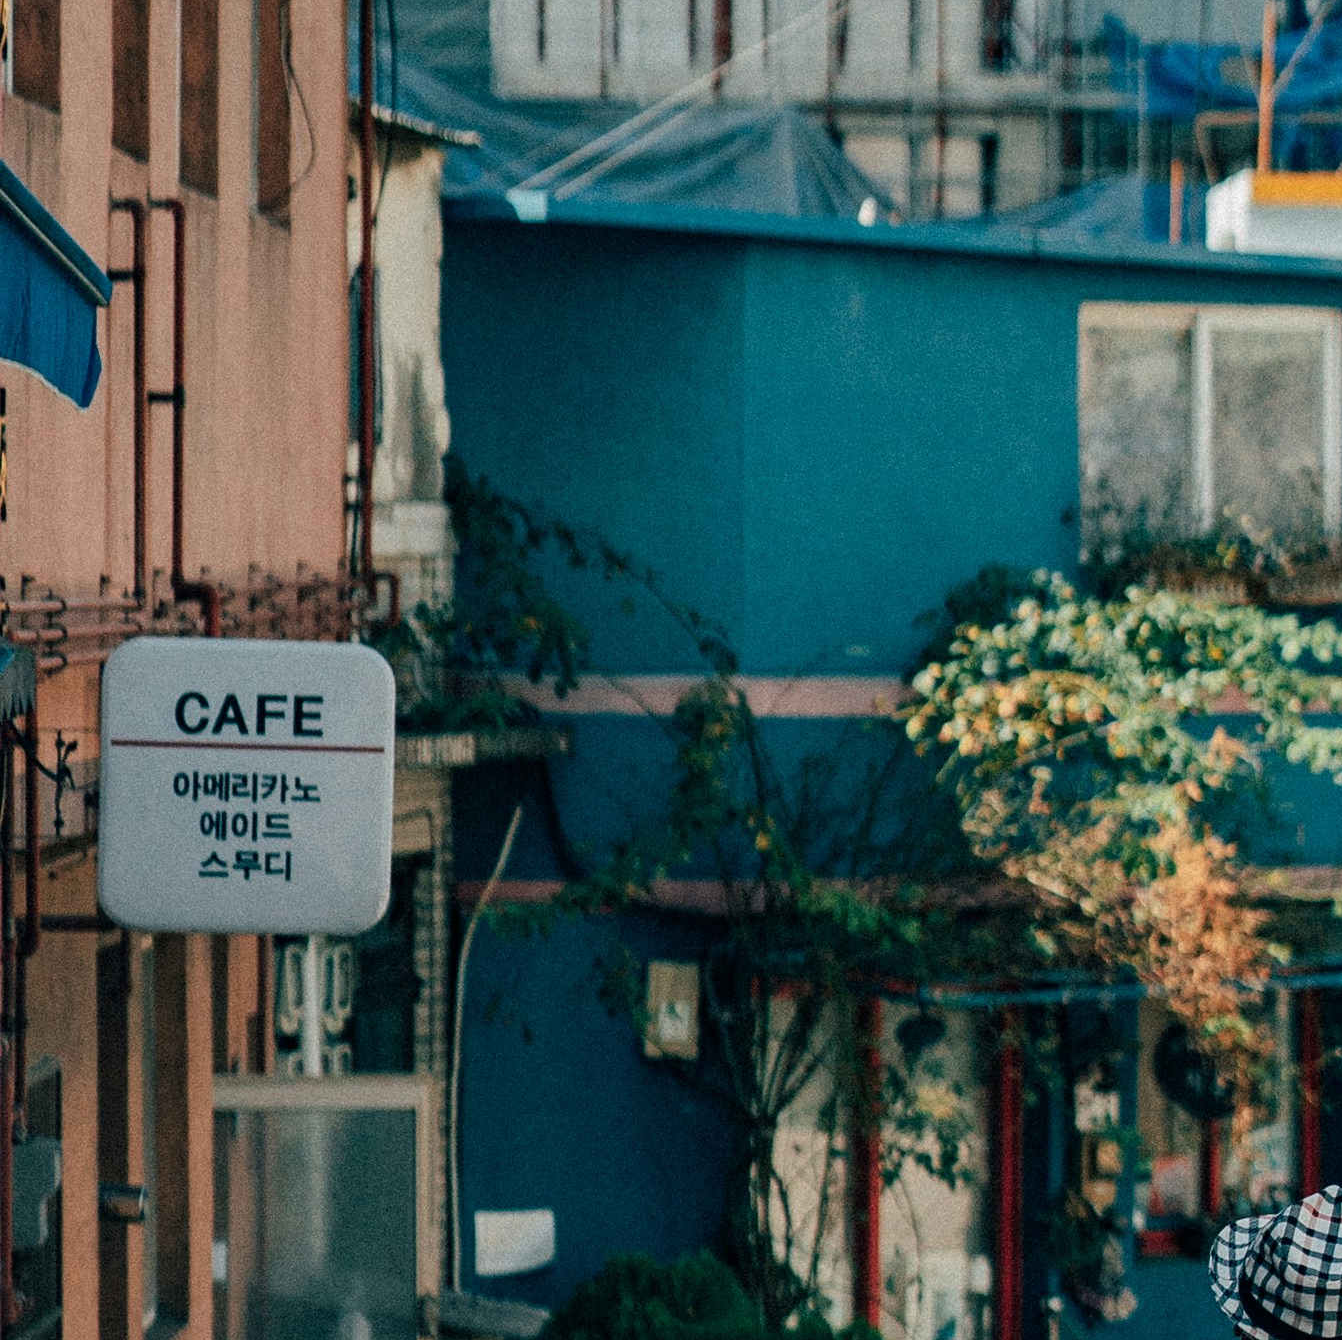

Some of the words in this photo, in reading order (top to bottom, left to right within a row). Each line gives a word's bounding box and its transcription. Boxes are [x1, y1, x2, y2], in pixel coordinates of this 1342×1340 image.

[174, 691, 324, 738] CAFE
[172, 770, 321, 804] 아메리카노
[199, 810, 292, 842] 에이드
[198, 850, 292, 882] 스무디
